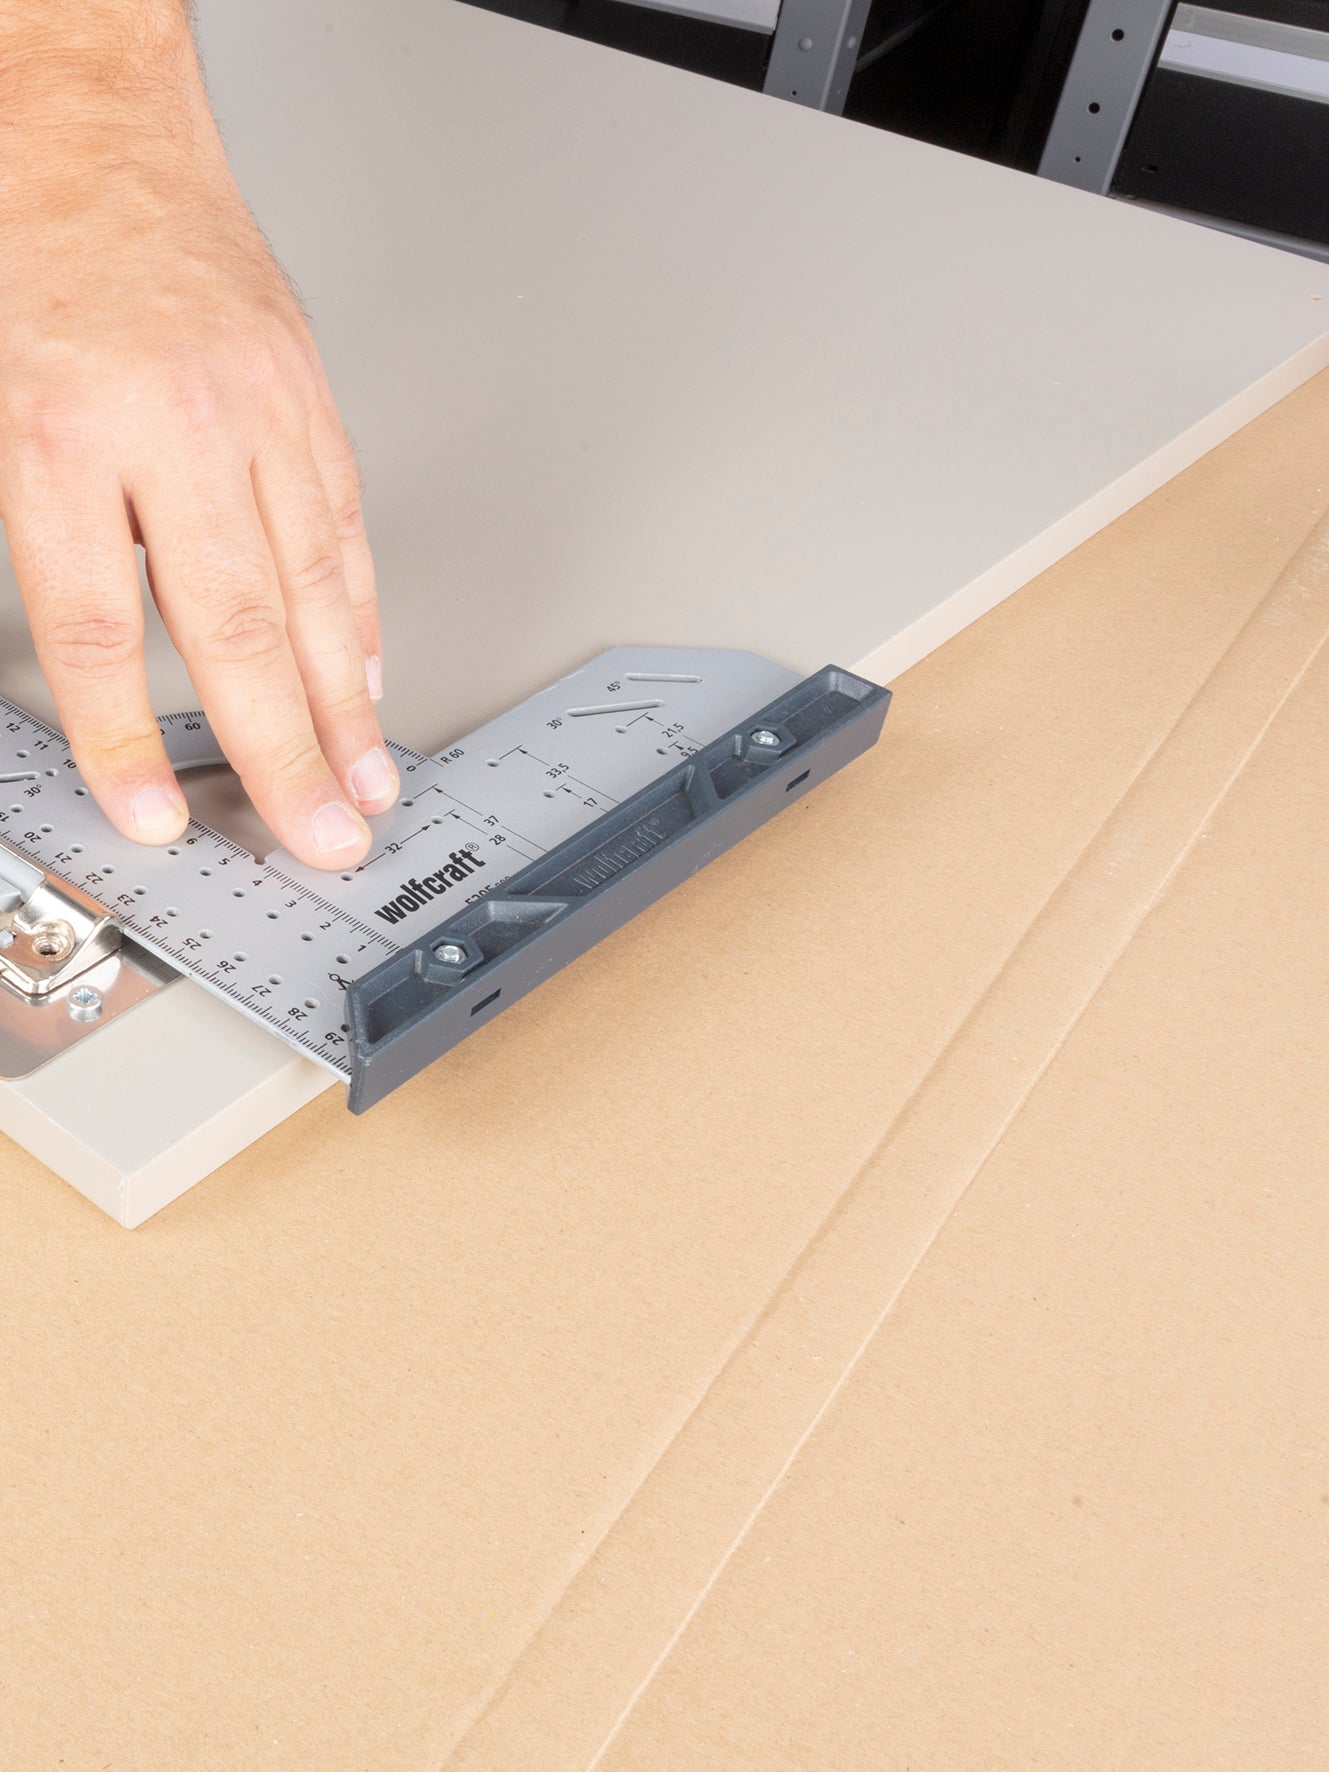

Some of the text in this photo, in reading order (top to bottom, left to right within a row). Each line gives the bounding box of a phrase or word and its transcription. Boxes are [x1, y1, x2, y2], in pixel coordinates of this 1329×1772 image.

[606, 681, 621, 693] 45°
[5, 722, 21, 733] 12
[184, 722, 201, 731] 60
[661, 722, 685, 738] 21,5
[34, 740, 49, 751] 11
[440, 748, 466, 765] R 60
[63, 758, 77, 769] 10
[545, 762, 570, 779] 33,5
[23, 783, 43, 798] 30°
[583, 797, 598, 808] 17
[483, 815, 500, 827] 37
[24, 831, 42, 843] 20
[186, 837, 198, 845] 6
[489, 834, 507, 846] 28
[384, 842, 403, 855] 32
[54, 852, 72, 864] 21
[218, 857, 231, 866] 5
[85, 872, 104, 885] 22
[251, 879, 263, 887] 4
[116, 893, 136, 906] 23
[284, 899, 297, 908] 3
[149, 915, 169, 928] 24
[319, 921, 332, 930] 2
[182, 937, 202, 951] 25
[357, 944, 367, 952] 1
[216, 960, 237, 974] 26
[251, 984, 272, 997] 27
[287, 1007, 309, 1022] 28
[324, 1032, 345, 1046] 29
